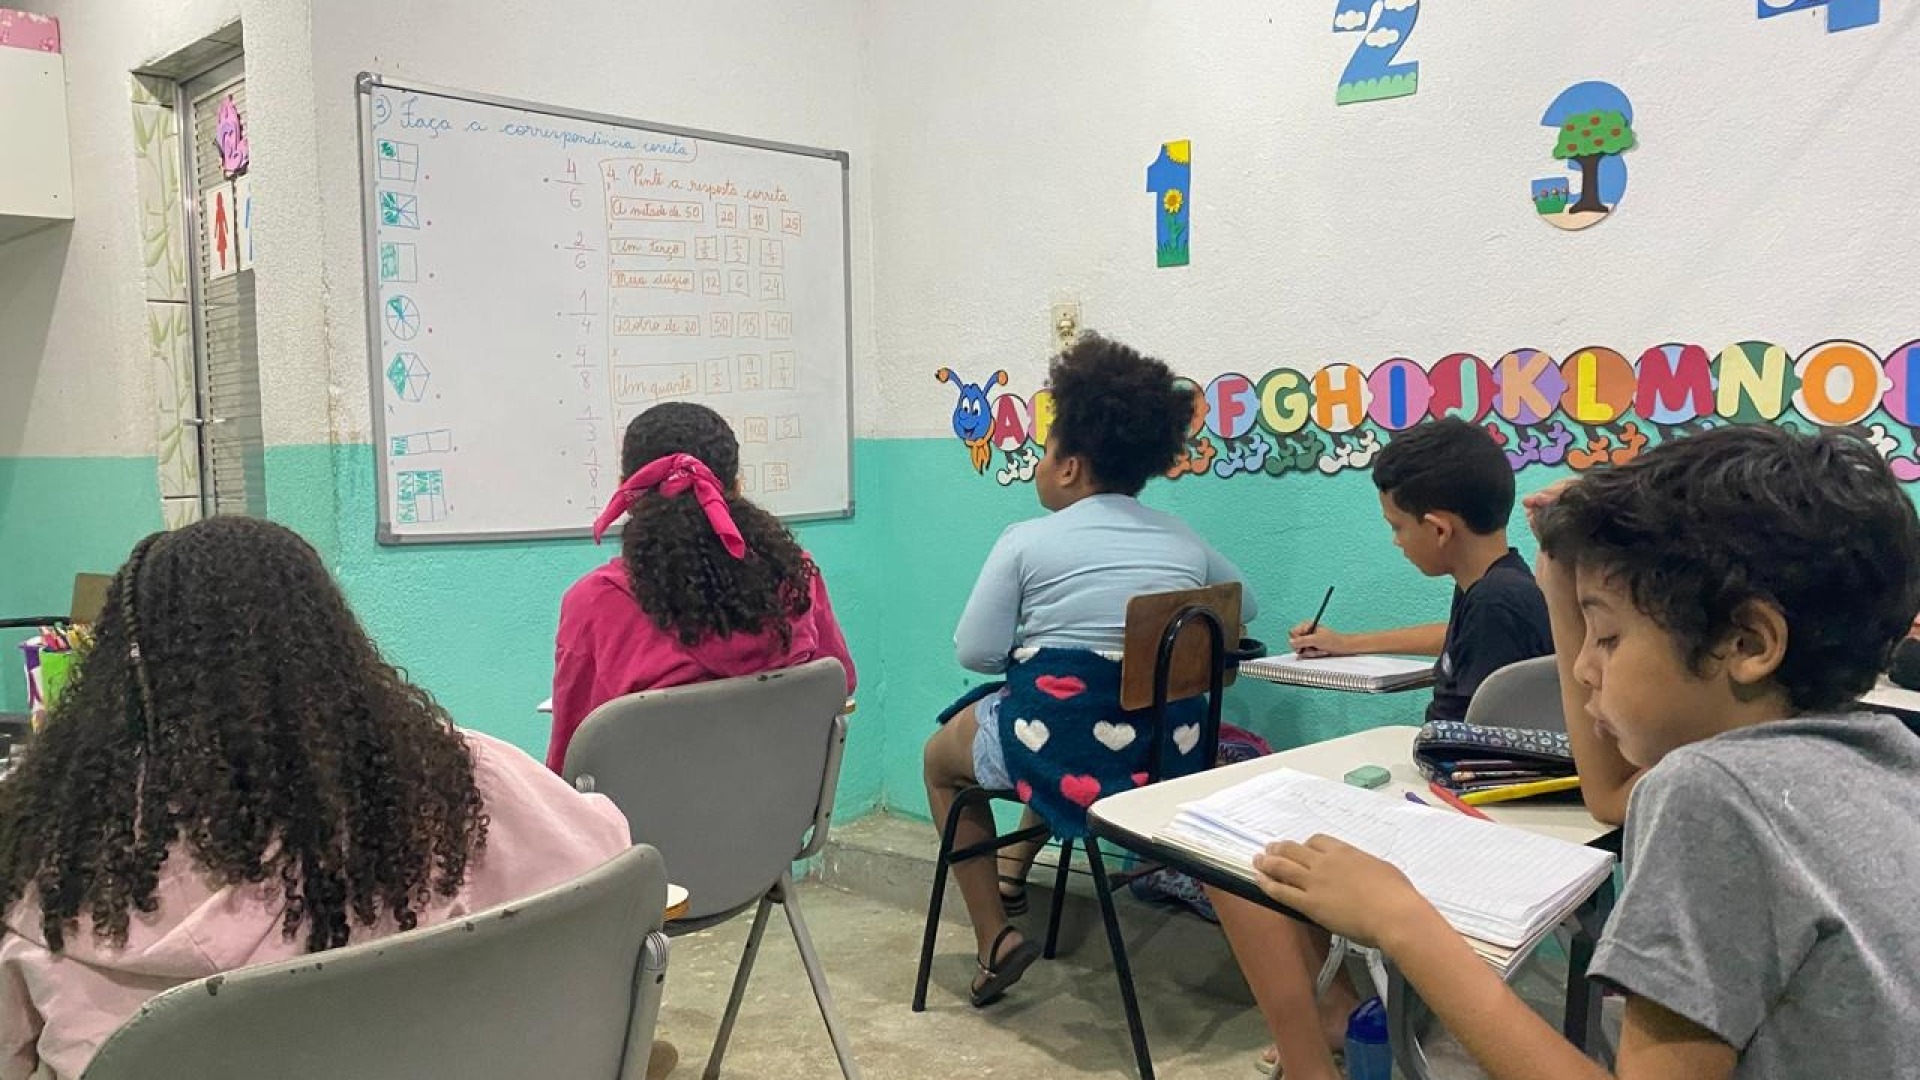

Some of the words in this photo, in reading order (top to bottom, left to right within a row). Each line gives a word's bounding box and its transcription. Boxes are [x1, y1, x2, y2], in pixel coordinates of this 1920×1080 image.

[400, 96, 452, 138] Faça
[464, 120, 487, 132] a
[643, 135, 689, 156] correta
[1531, 80, 1636, 231] 3
[570, 189, 582, 208] 6
[1146, 139, 1191, 268] 1
[993, 404, 1027, 446] A
[1217, 377, 1249, 437] F
[1260, 373, 1309, 433] G
[1315, 363, 1362, 429] H
[1389, 364, 1407, 428] I
[1444, 356, 1477, 422] J
[1500, 351, 1553, 420] K
[1577, 351, 1614, 421] L
[1634, 344, 1716, 418] M
[1715, 344, 1786, 419] N
[1802, 345, 1878, 422] O
